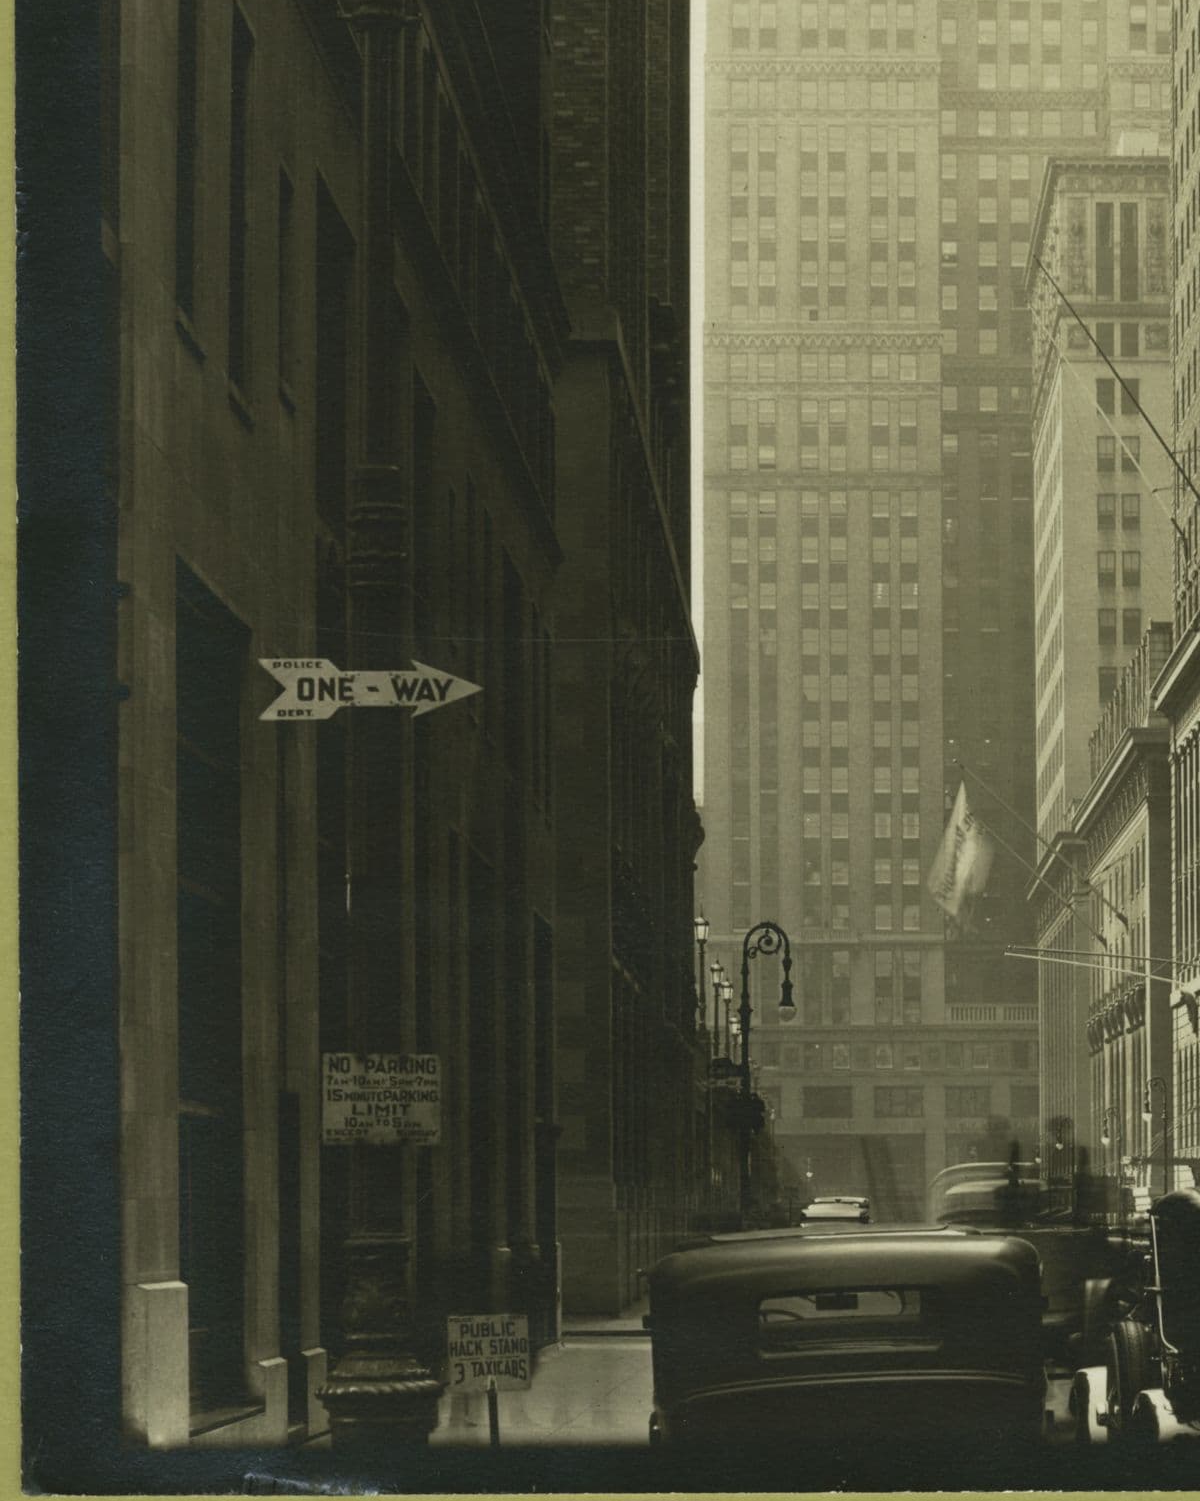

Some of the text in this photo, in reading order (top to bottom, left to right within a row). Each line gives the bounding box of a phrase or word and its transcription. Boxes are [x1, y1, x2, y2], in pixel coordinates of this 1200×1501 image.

[272, 660, 323, 669] POLICE
[296, 677, 355, 702] ONE
[391, 677, 454, 702] WAY
[328, 1056, 437, 1075] NO PARKING
[327, 1089, 439, 1102] 15 MINUTE PARKING
[351, 1103, 411, 1117] LIMIT
[459, 1321, 516, 1338] PUBLIC
[449, 1337, 528, 1358] HACK STAND
[454, 1358, 527, 1385] 3 TAXICABS
